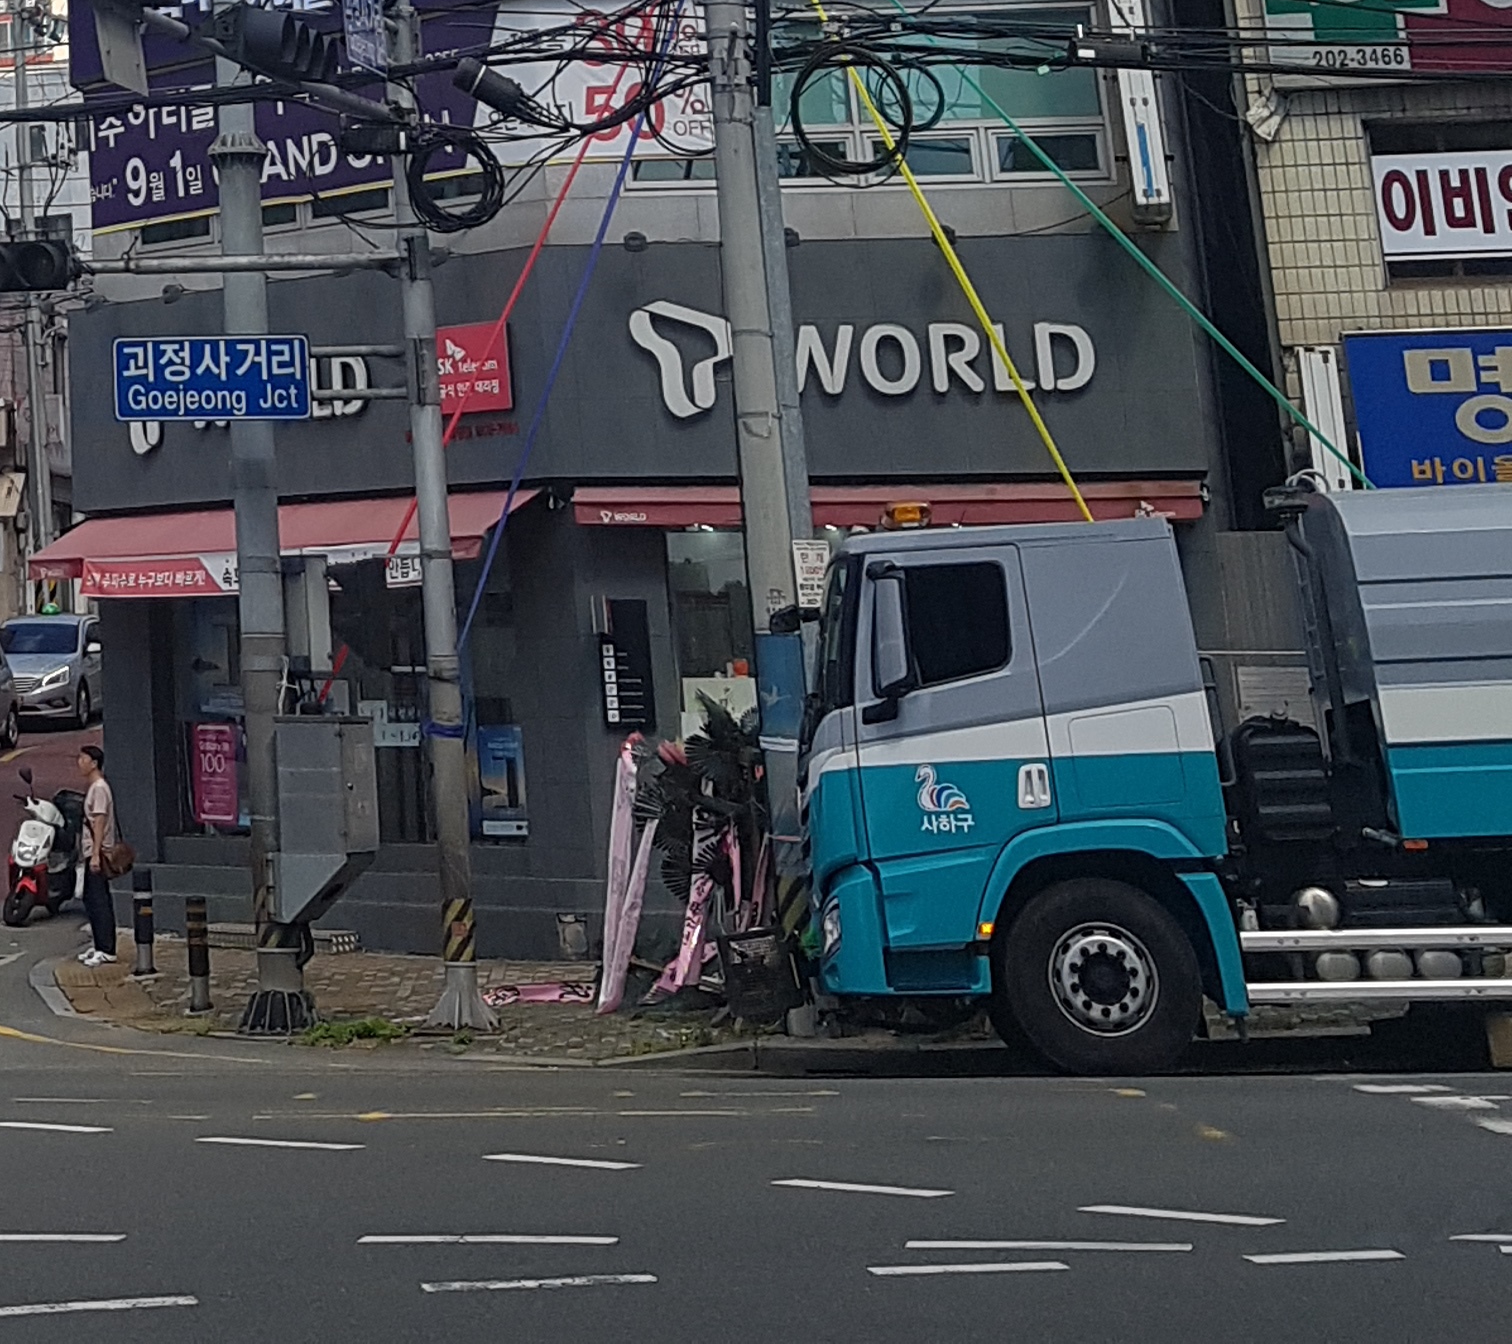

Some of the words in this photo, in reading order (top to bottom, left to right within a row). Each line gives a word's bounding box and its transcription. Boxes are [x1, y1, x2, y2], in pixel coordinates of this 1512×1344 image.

[1313, 46, 1405, 69] 202-3466
[126, 158, 165, 205] 9월
[170, 150, 204, 198] 1일
[121, 339, 302, 385] 괴정사거리
[437, 358, 454, 375] SK
[796, 322, 1096, 394] WORLD
[127, 385, 247, 416] Goejeong
[259, 383, 299, 411] Jct
[199, 753, 224, 773] 100
[921, 814, 974, 833] 사하구
